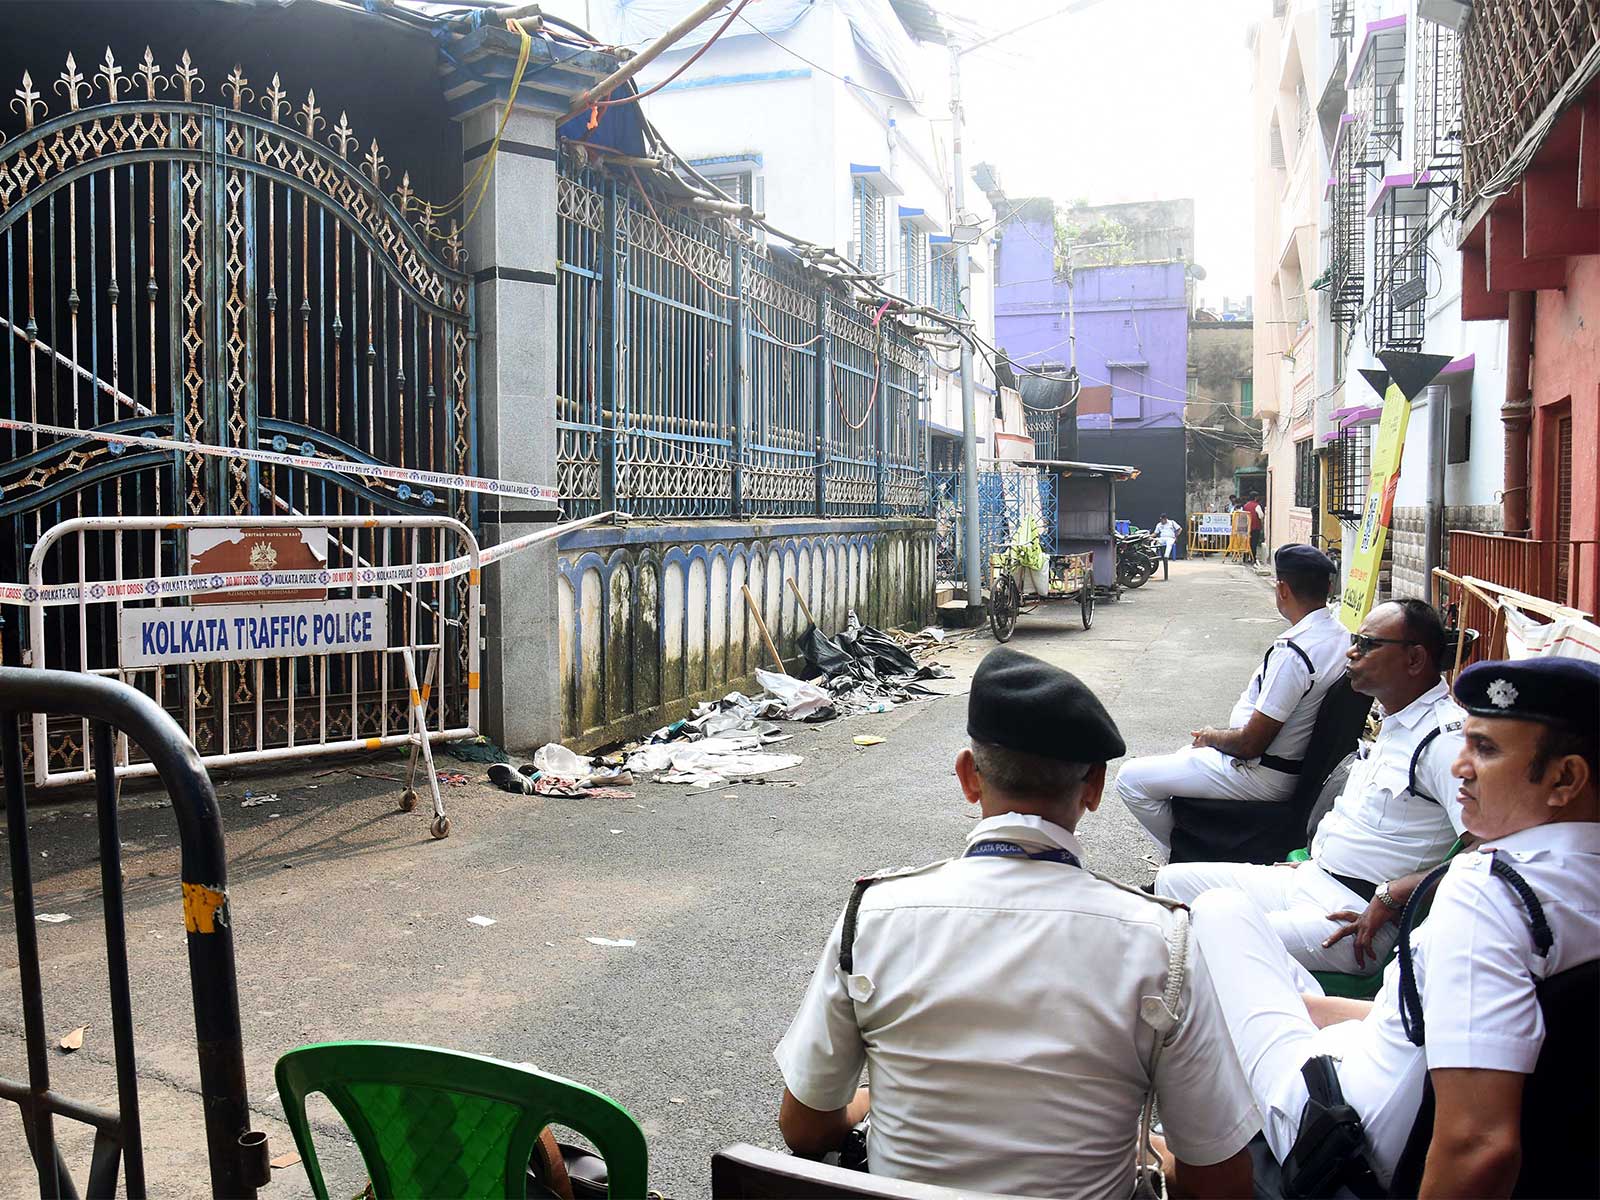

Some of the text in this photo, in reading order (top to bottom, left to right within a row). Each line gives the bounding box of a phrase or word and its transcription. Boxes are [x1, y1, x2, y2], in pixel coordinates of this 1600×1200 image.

[421, 474, 439, 483] KOLKATA
[439, 477, 453, 485] POLICE
[465, 479, 470, 487] DO
[477, 481, 489, 490] CROSS
[499, 484, 516, 493] KOLKATA
[516, 486, 529, 495] POLICE
[6, 588, 22, 600] CROSS
[40, 589, 66, 600] KOLKATA
[107, 586, 115, 596] DO
[115, 585, 126, 595] NOT
[127, 584, 143, 595] CROSS
[162, 580, 187, 592] KOLKATA
[188, 578, 208, 590] POLICE
[226, 576, 232, 587] DO
[233, 576, 242, 586] NOT
[243, 575, 259, 585] CROSS
[274, 574, 298, 584] KOLKATA
[299, 573, 317, 584] POLICE
[332, 572, 338, 583] DO
[338, 572, 346, 582] NOT
[347, 571, 362, 582] CRS
[376, 571, 397, 581] KOLKATA
[398, 568, 413, 579] POLICE
[428, 567, 435, 577] DO
[436, 566, 444, 576] NOT
[142, 611, 372, 655] KOLKATA TRAFFIC POLICE
